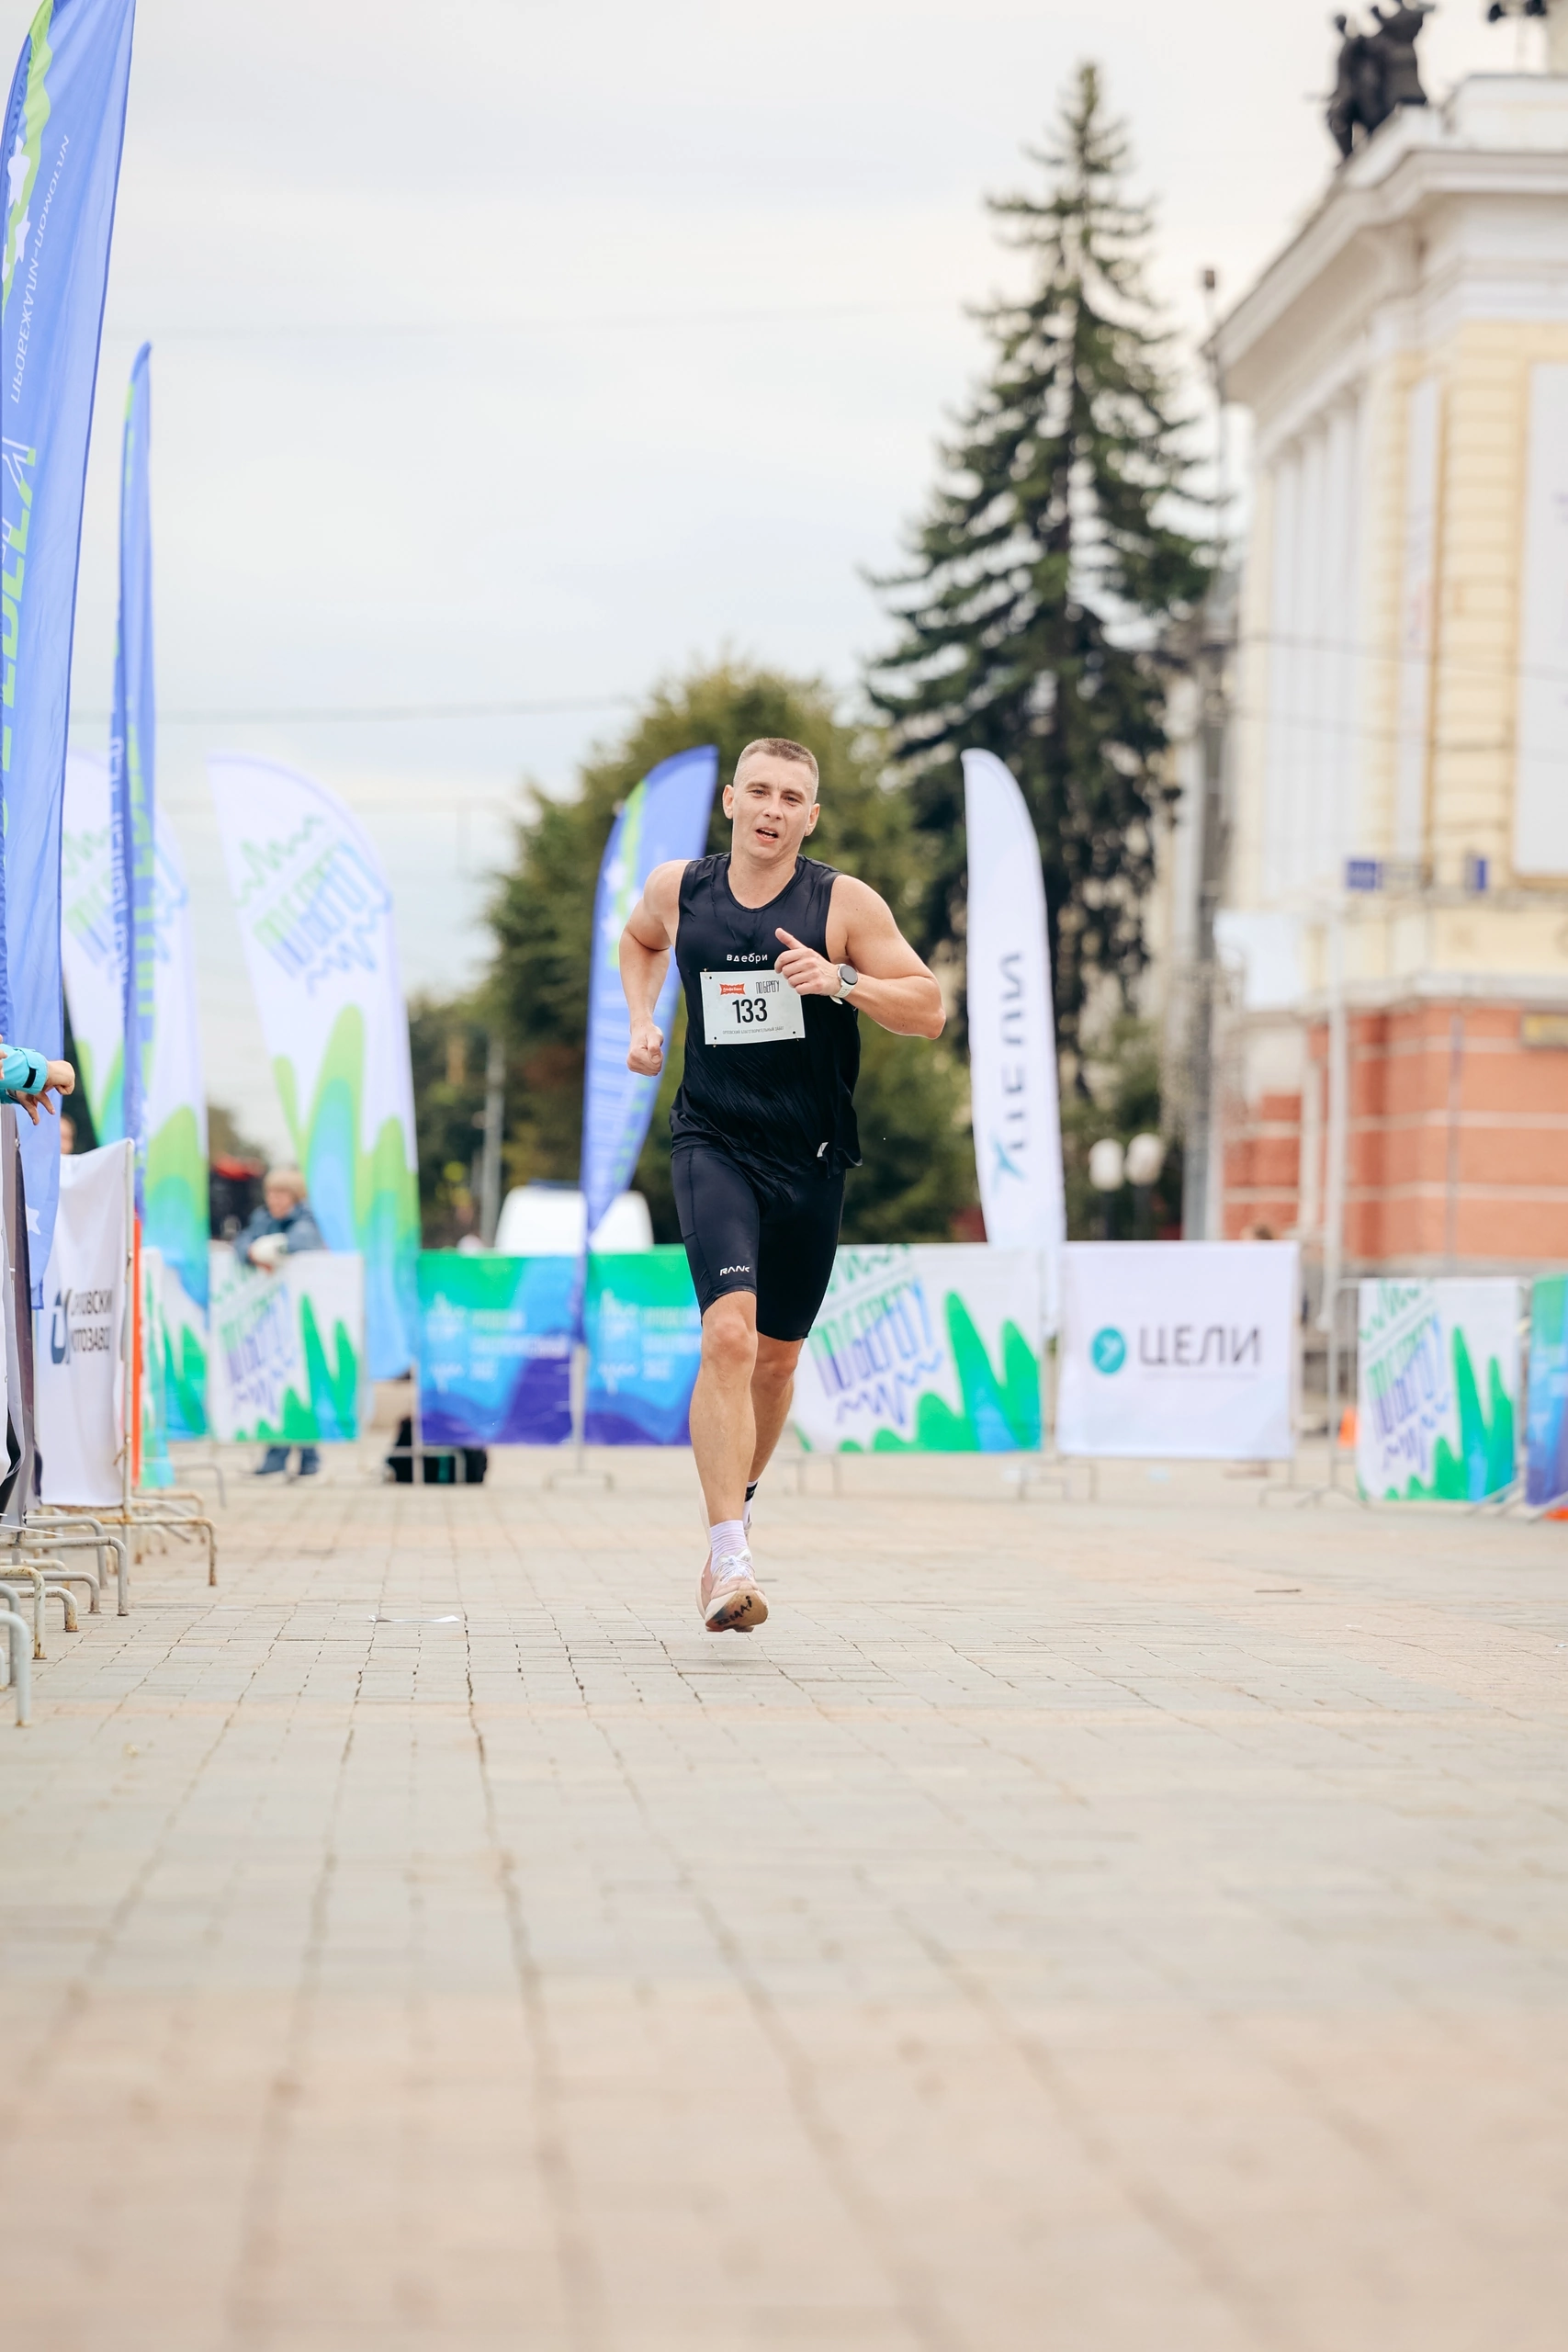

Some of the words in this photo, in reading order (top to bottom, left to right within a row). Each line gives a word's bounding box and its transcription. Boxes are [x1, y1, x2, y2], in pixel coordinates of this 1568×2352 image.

[732, 998, 768, 1023] 133
[719, 1265, 750, 1276] RANK
[1139, 1326, 1261, 1366] ЦЕЛИ
